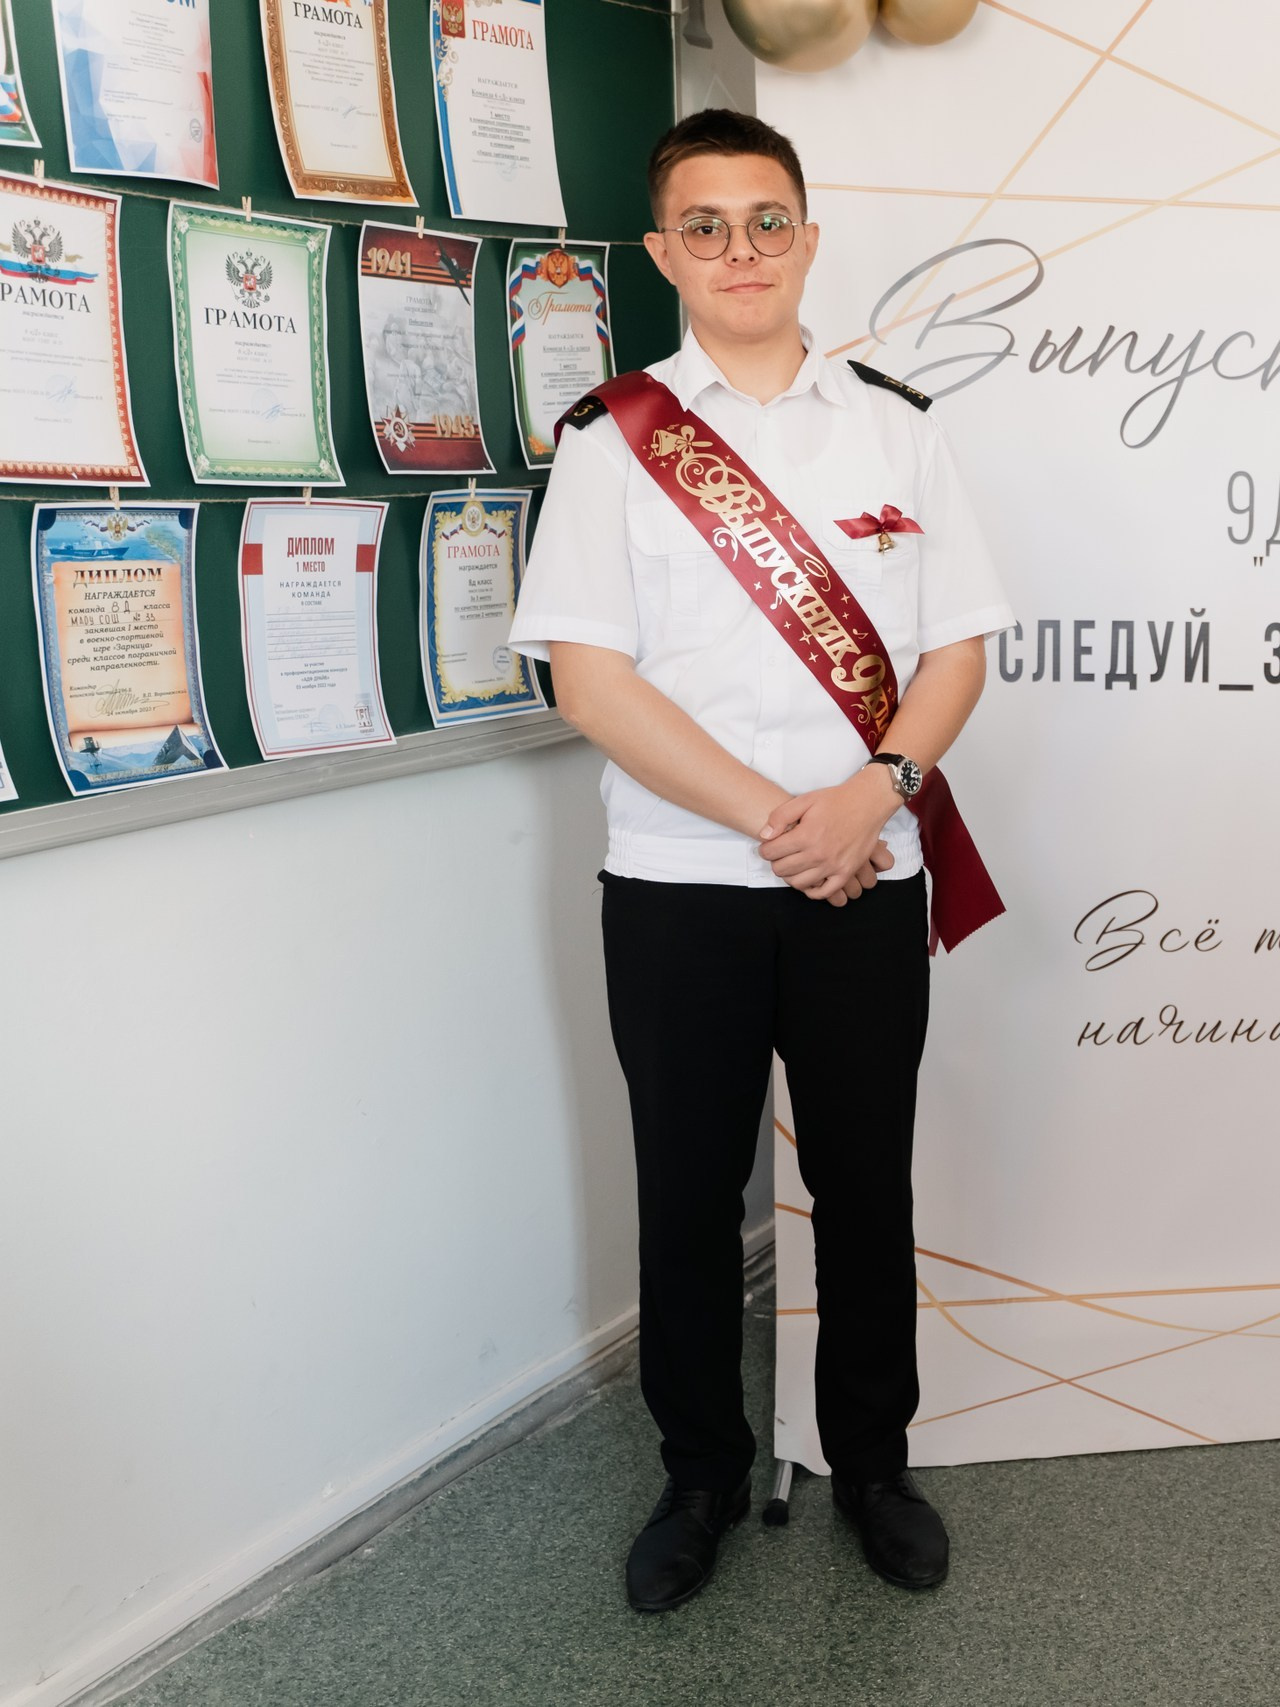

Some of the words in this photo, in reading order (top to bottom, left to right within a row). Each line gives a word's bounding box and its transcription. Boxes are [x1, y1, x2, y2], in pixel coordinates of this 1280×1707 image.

[293, 1, 363, 29] ГРАМОТА
[472, 19, 534, 50] ГРАМОТА
[367, 247, 411, 276] 1941
[0, 282, 92, 313] РАМОТА
[528, 291, 593, 326] Грамота
[204, 307, 297, 334] ГРАМОТА
[432, 414, 475, 437] 1945
[287, 537, 335, 558] ДИПЛОМ
[447, 544, 500, 559] ГРАМОТА
[296, 562, 300, 572] 1
[302, 561, 326, 572] МЕСТО
[458, 564, 498, 572] награждается
[73, 568, 163, 588] ДИПЛОМ
[280, 580, 342, 588] НАГРАЖДАЕТСЯ
[84, 590, 156, 600] НАГРАЖДАЕТСЯ
[68, 605, 105, 614] команда
[86, 631, 164, 644] военно-спортивной
[67, 657, 90, 667] среди
[93, 654, 126, 662] классов
[128, 647, 176, 660] пограничной
[93, 646, 110, 654] игре
[90, 662, 160, 672] направленности.
[1073, 889, 1223, 972] Всё
